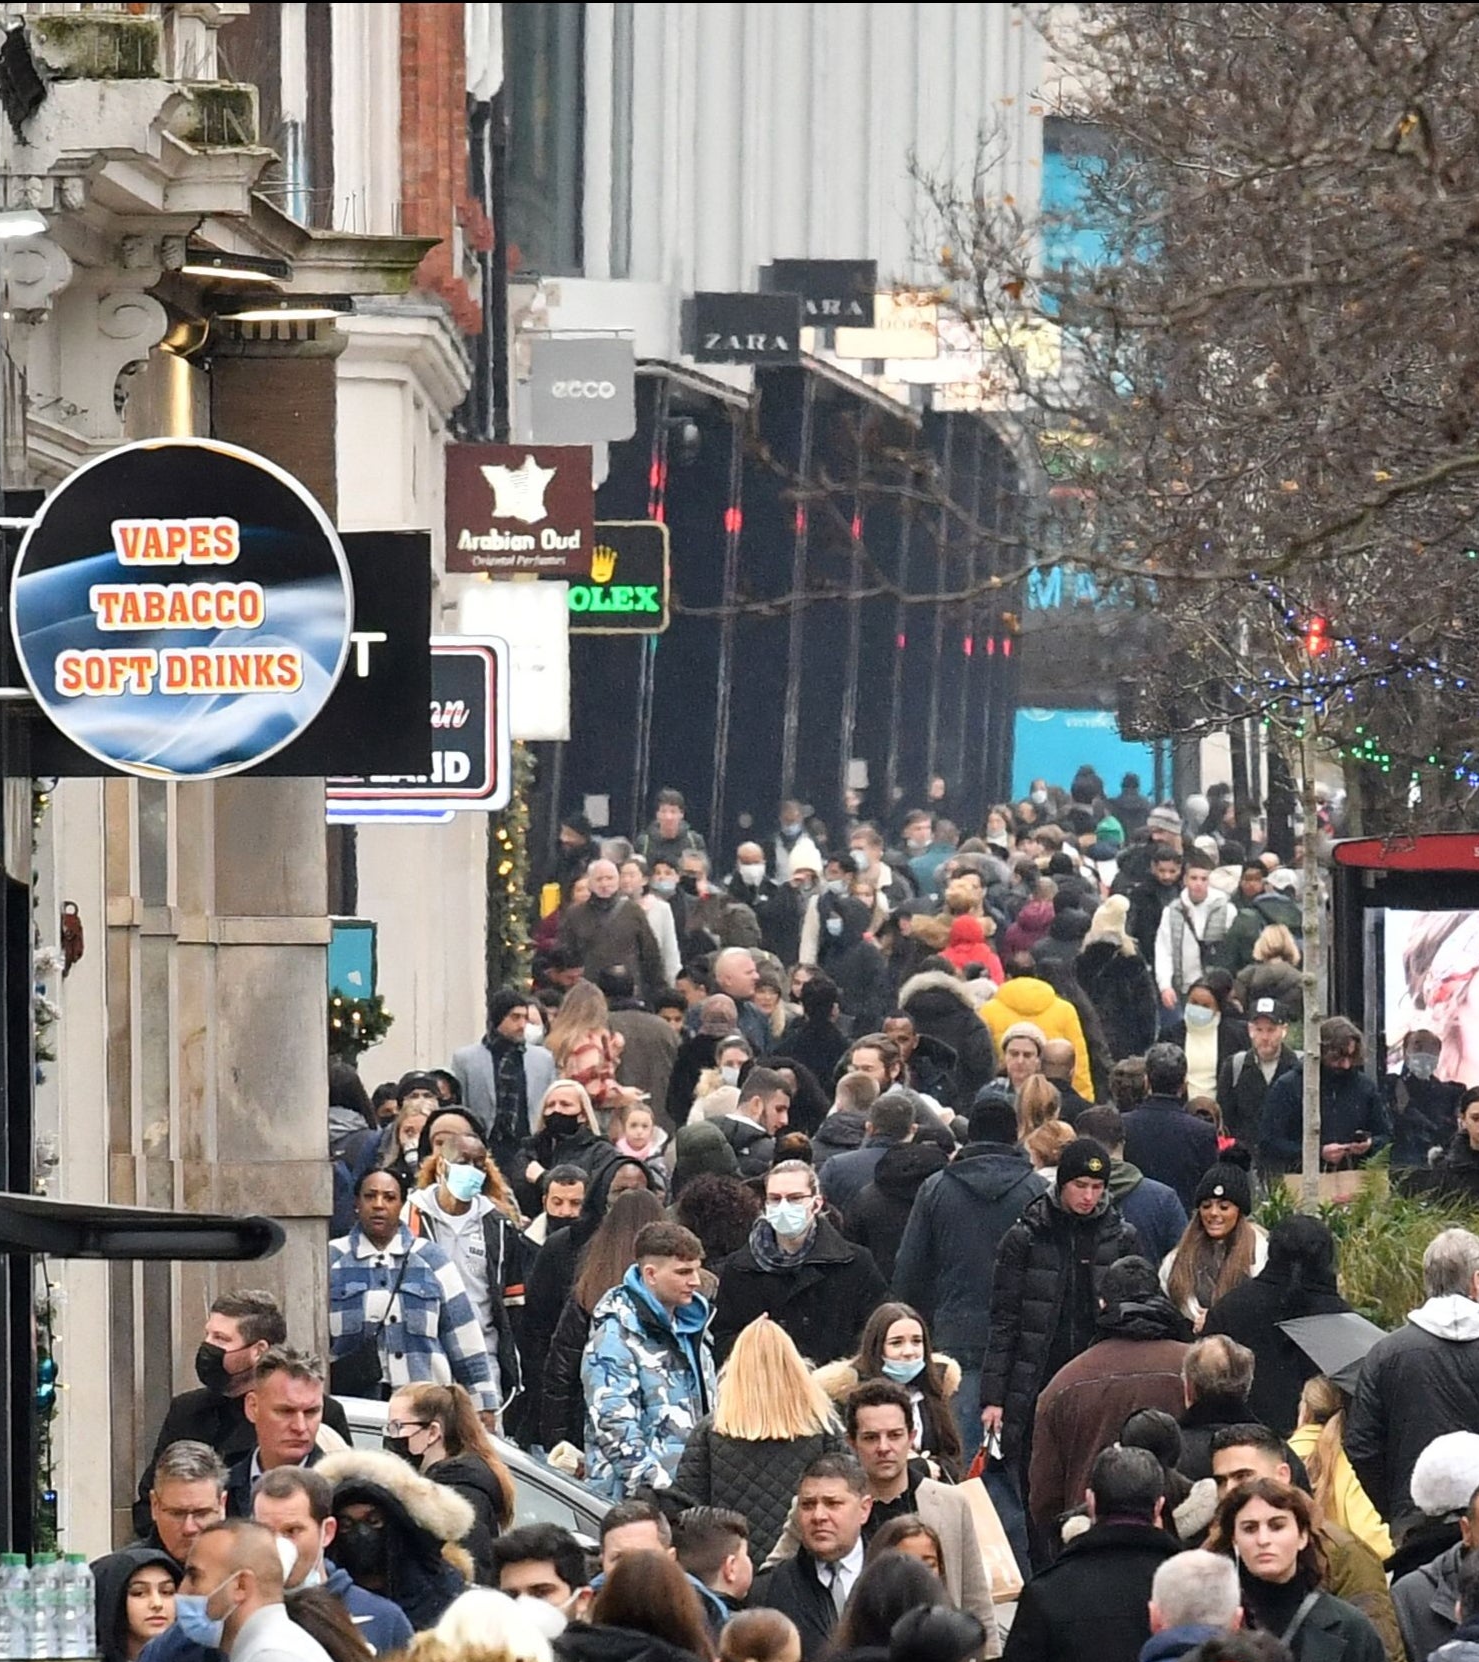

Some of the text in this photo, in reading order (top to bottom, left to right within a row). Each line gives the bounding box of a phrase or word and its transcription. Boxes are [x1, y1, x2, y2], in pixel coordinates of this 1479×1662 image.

[805, 299, 863, 316] ARA
[704, 333, 789, 351] ZARA
[551, 380, 615, 399] ecco
[115, 520, 237, 564] VAPES
[457, 528, 580, 550] Arabian Oud
[95, 588, 262, 627] TABACCO
[568, 586, 660, 612] OLEX
[350, 632, 387, 677] T
[59, 649, 301, 693] SOFT DRINKS
